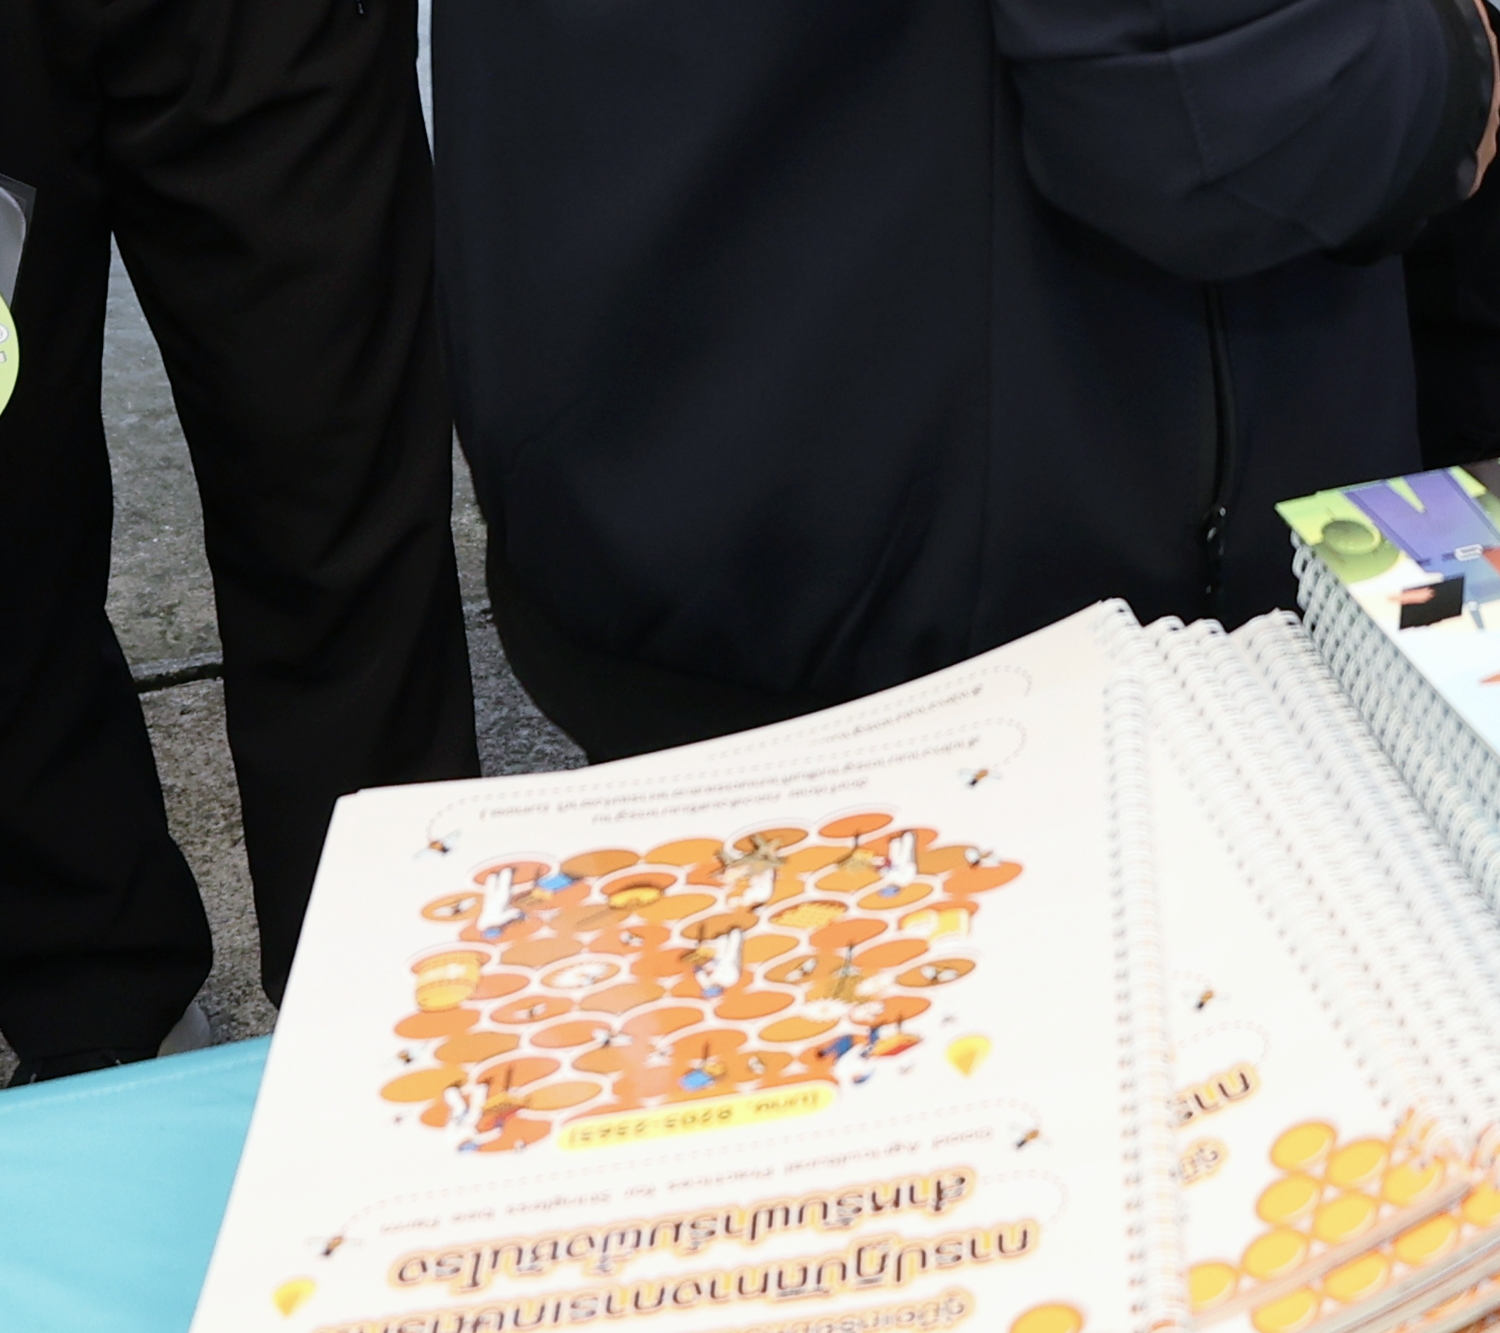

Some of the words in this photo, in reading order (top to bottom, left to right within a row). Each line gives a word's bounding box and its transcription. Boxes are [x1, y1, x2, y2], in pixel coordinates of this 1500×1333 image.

[394, 1173, 966, 1297] สำหรับฟาร์มผึ้งชันโรง
